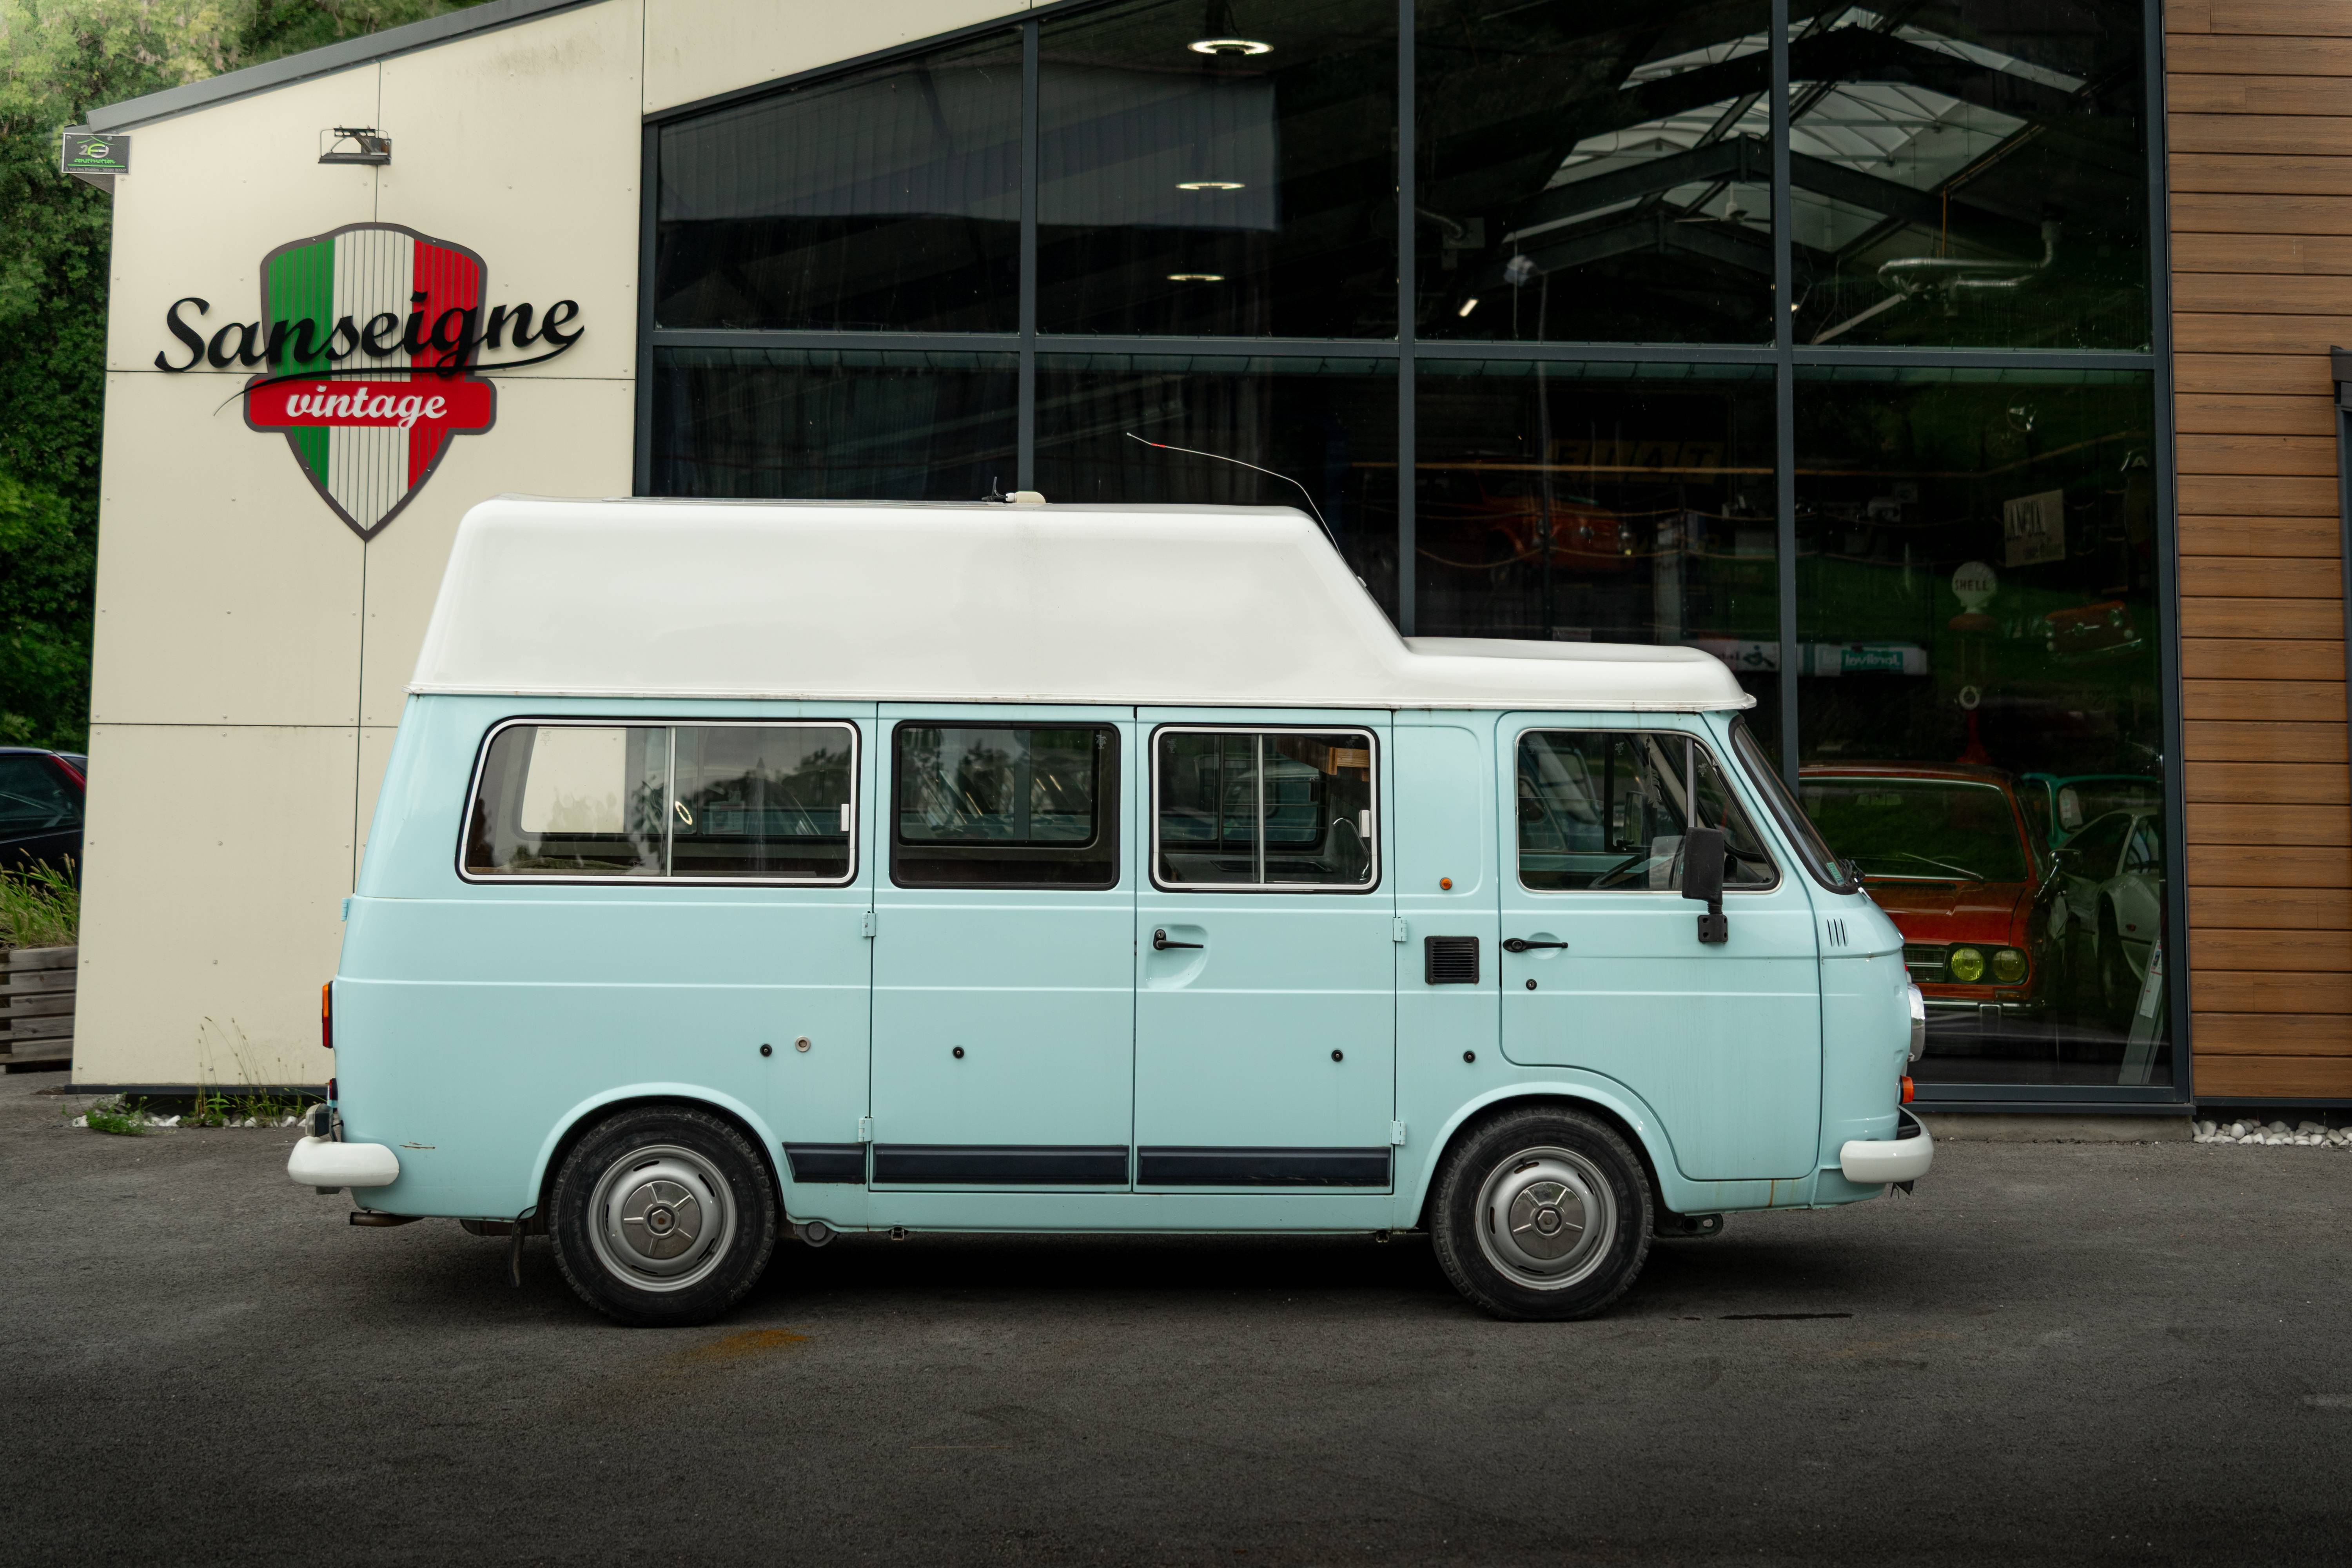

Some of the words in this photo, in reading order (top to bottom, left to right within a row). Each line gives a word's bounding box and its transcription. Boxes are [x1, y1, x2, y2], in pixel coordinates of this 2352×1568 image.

[154, 291, 584, 376] Sanseigne
[286, 384, 447, 429] vintage
[1556, 445, 1713, 475] FIAT
[1955, 579, 1988, 591] SHELL
